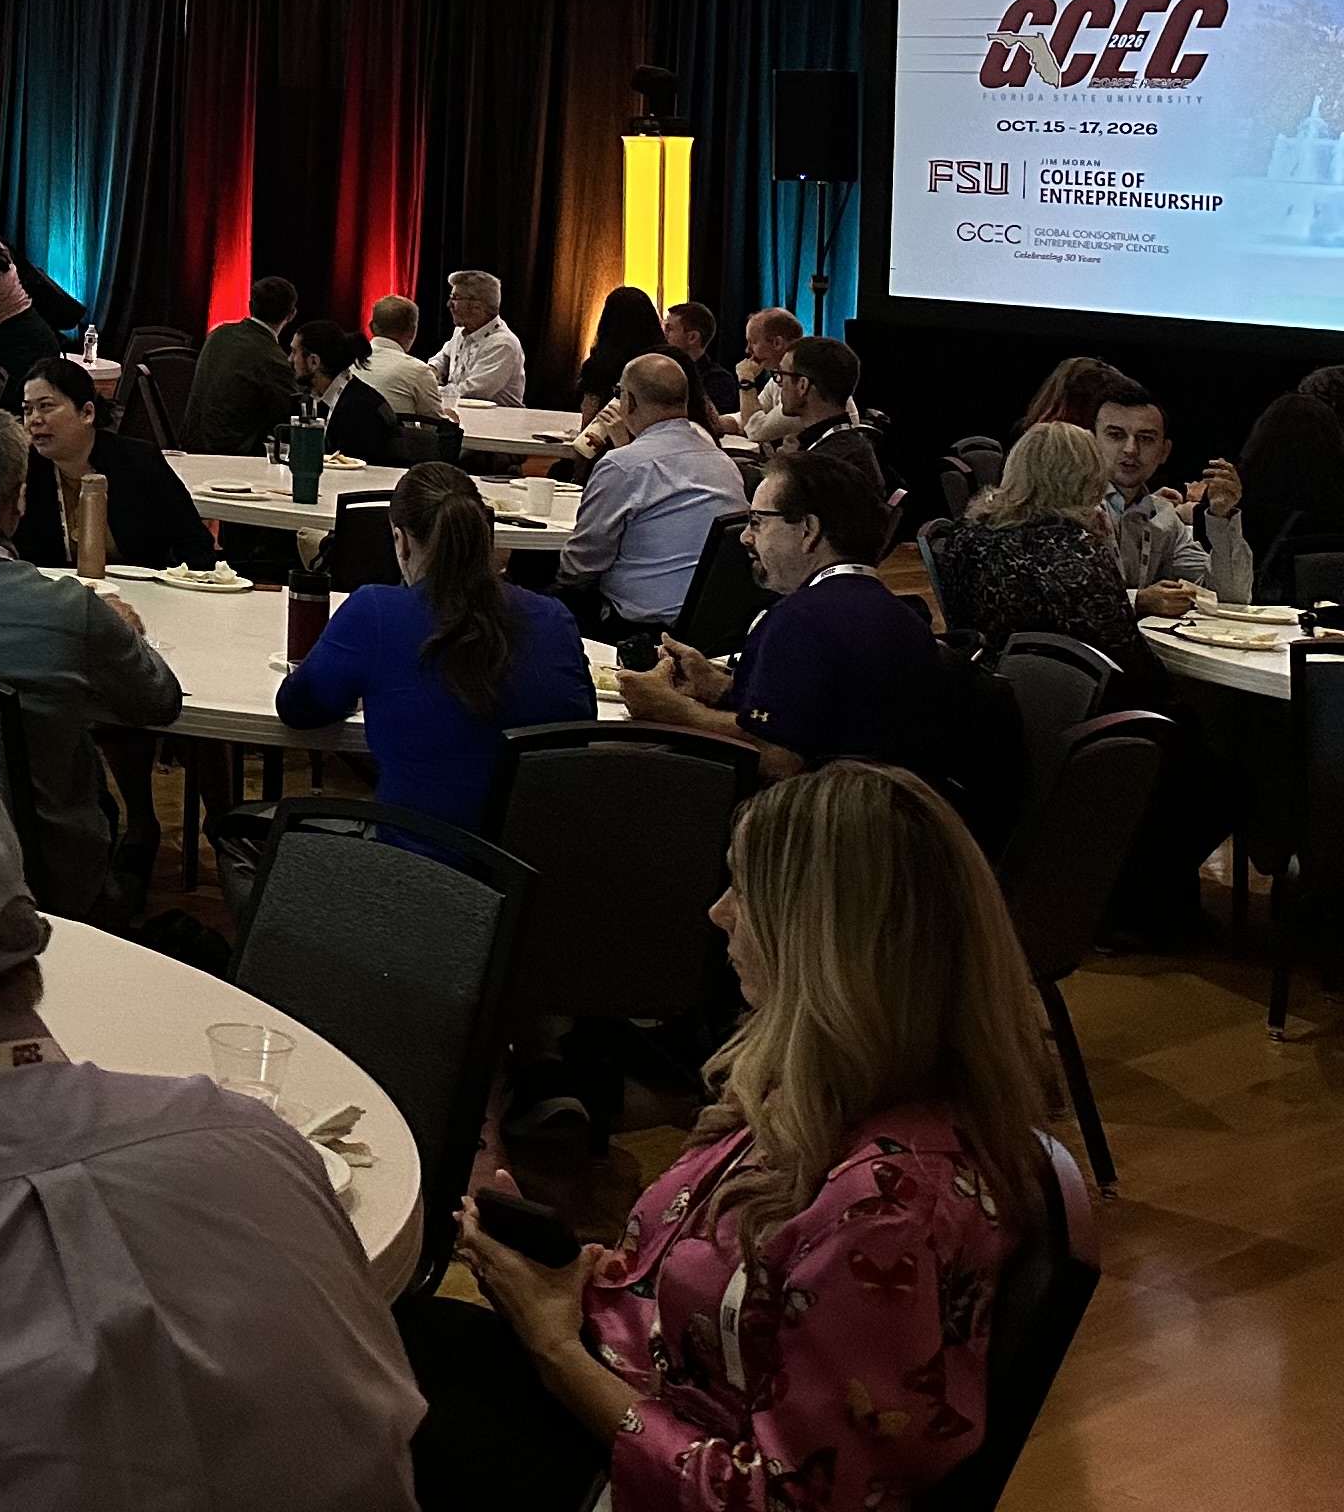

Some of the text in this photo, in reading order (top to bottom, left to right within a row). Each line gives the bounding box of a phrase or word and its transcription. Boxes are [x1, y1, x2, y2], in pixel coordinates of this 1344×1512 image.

[1108, 34, 1143, 48] 2026
[983, 92, 1203, 104] FLORIDA STATE UNIVERSITY
[996, 120, 1040, 133] OCT.
[1043, 121, 1065, 133] 15
[1079, 121, 1103, 136] 17,
[1107, 122, 1158, 136] 2026
[1040, 158, 1101, 167] JIM MORAN
[927, 159, 1009, 195] FSU
[1040, 168, 1145, 188] COLLEGE OF
[1040, 188, 1223, 211] ENTREPRENEURSHIP
[957, 222, 1022, 244] GCEC
[1034, 227, 1156, 243] GLOBAL CONSORTIUM OF
[1126, 243, 1170, 255] CENTERS
